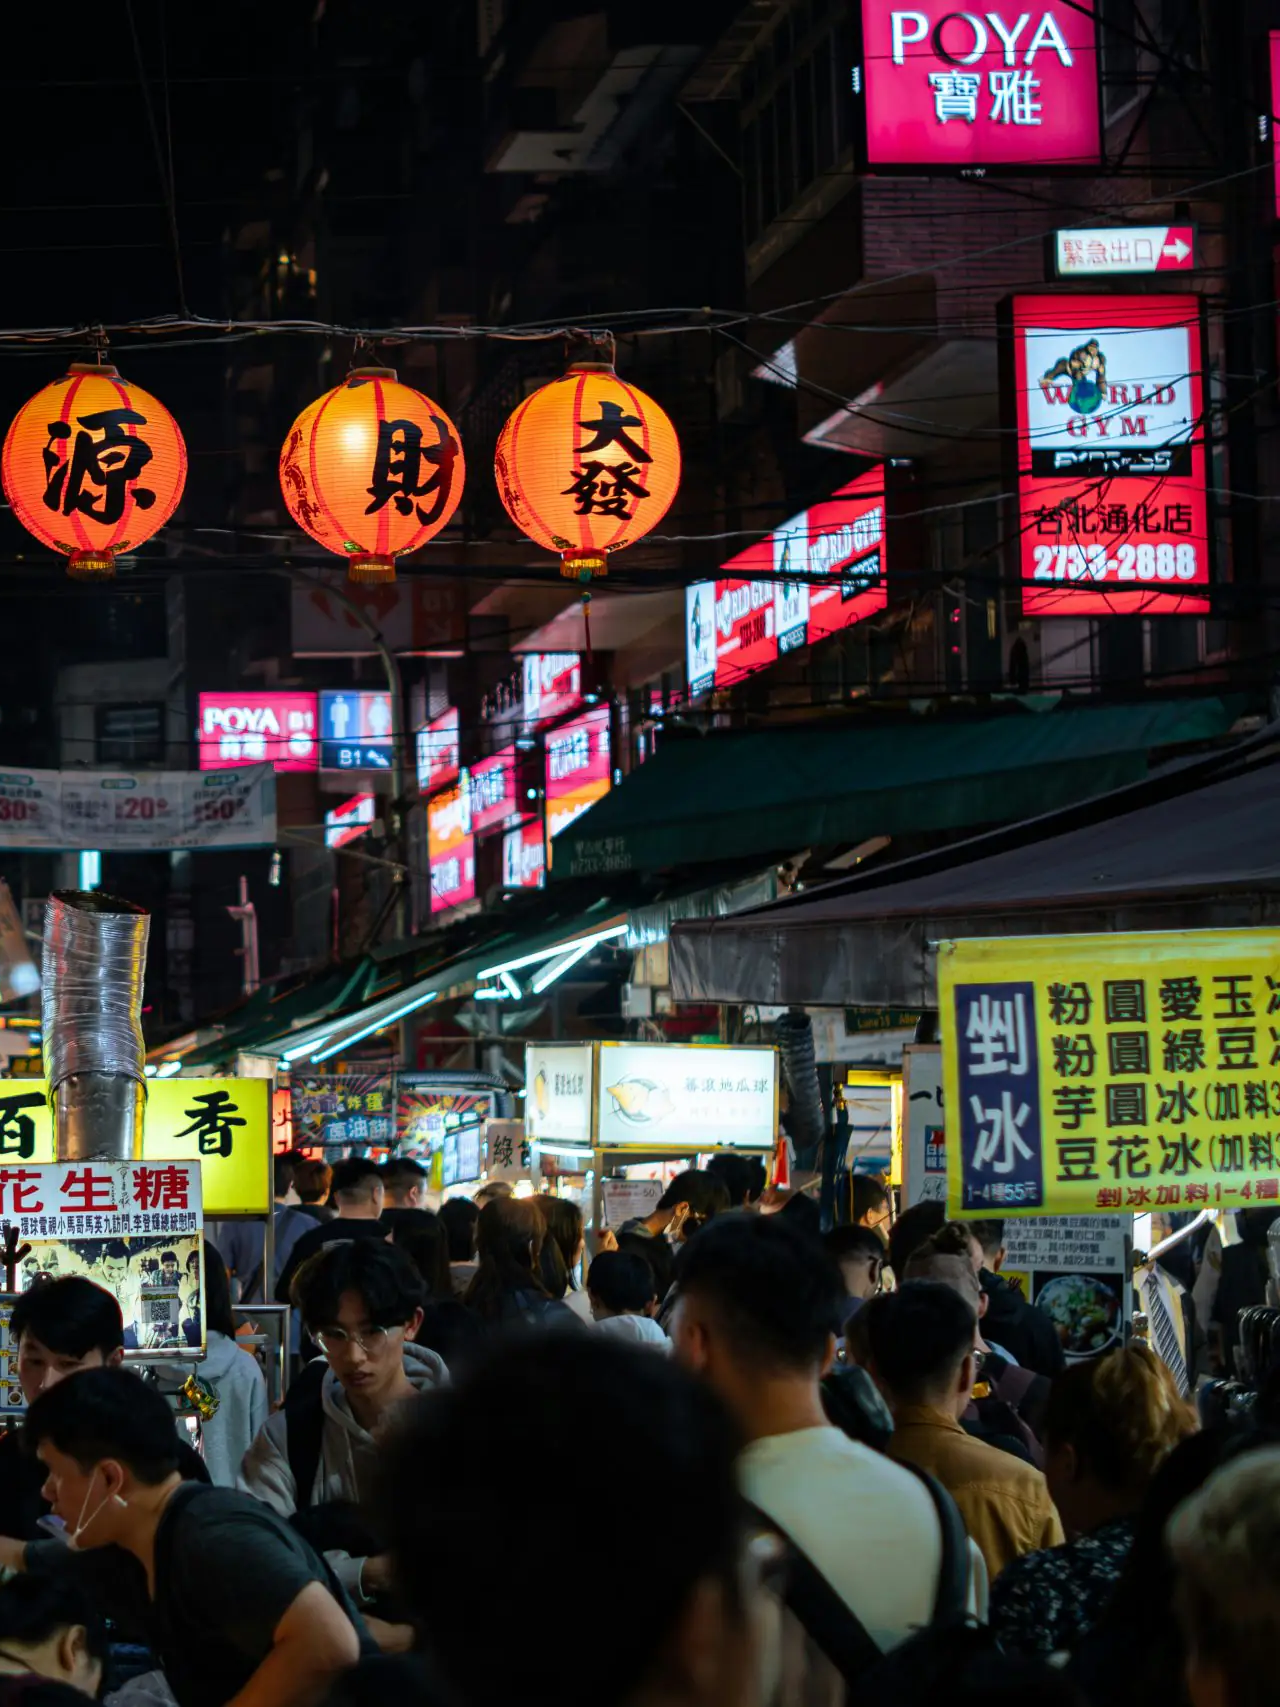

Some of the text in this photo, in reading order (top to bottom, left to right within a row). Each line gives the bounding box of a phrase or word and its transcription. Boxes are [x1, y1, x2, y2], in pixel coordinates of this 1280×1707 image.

[890, 11, 1073, 67] POYA
[928, 69, 1042, 126] 寶雅
[1062, 237, 1155, 267] 緊急出口
[1066, 414, 1149, 438] GYM
[42, 408, 157, 526] 源
[364, 415, 460, 526] 財
[560, 401, 654, 521] 大發
[1033, 502, 1193, 536] 台北通化店
[1032, 543, 1197, 581] 2733-2888
[203, 706, 280, 735] POYA
[339, 749, 362, 766] B1
